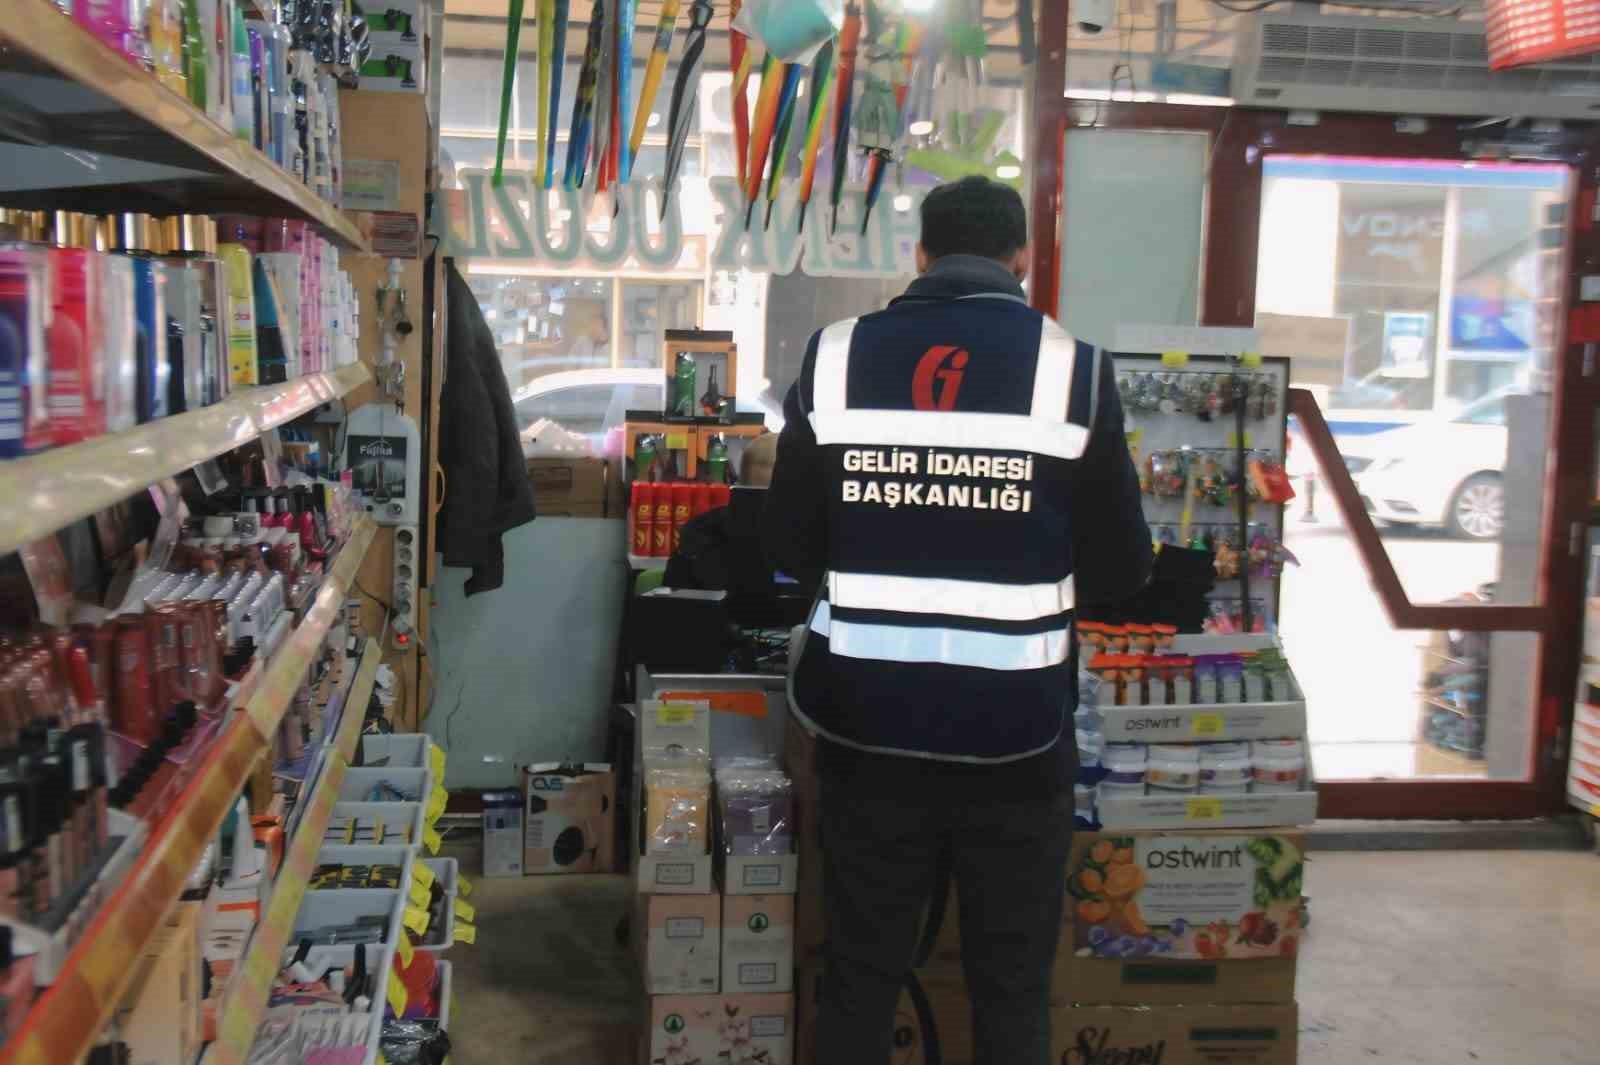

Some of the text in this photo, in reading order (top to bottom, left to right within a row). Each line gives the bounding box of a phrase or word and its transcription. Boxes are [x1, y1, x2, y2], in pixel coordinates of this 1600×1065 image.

[843, 447, 1033, 481] GELİR İDARESİ
[841, 480, 1032, 513] BAŞKANLIĞI
[1146, 844, 1242, 869] ostwint
